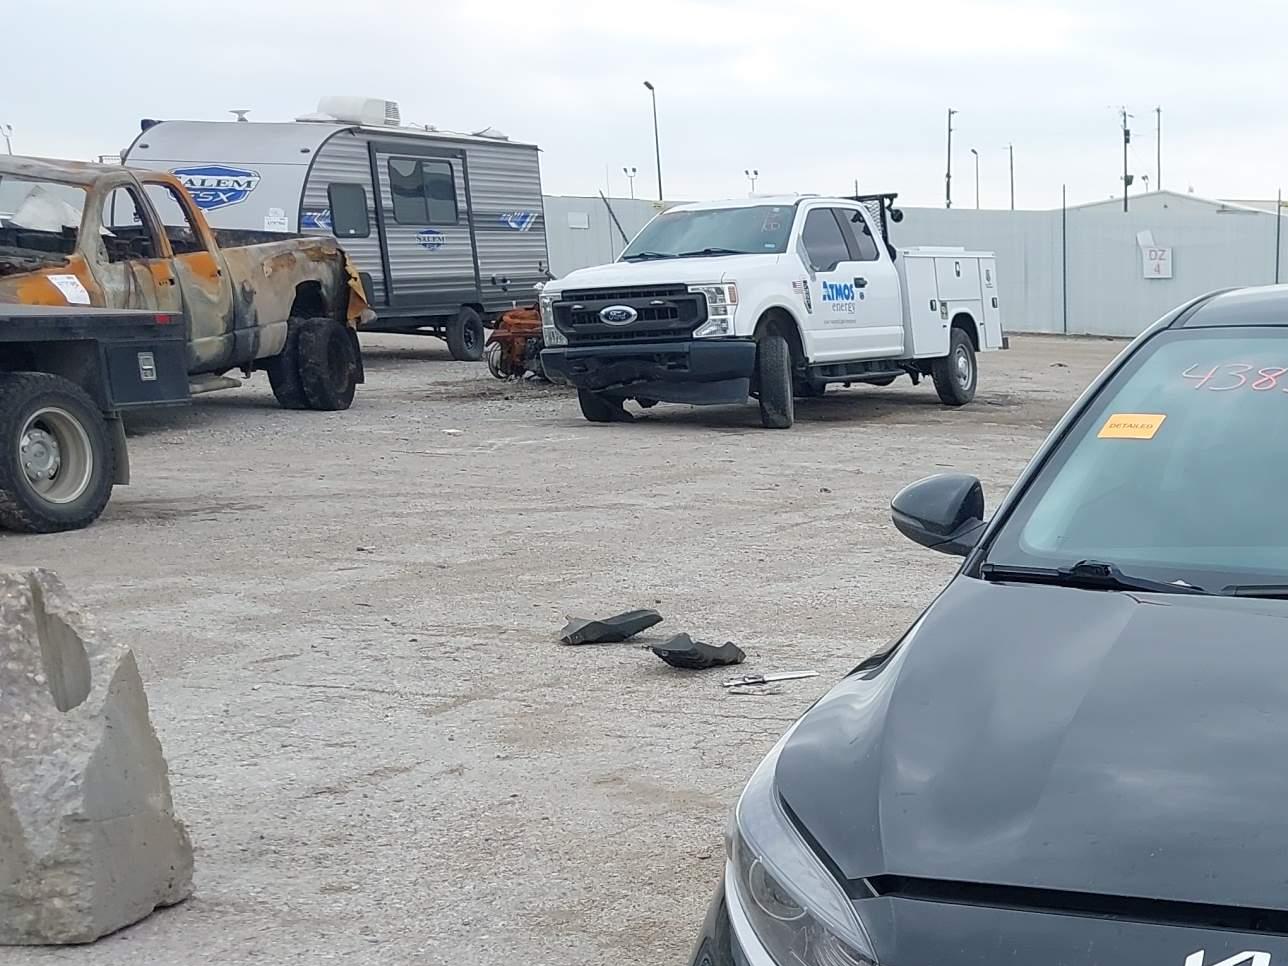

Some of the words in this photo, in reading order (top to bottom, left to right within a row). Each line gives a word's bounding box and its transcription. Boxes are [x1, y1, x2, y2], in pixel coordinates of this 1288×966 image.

[178, 177, 253, 189] ALEM
[823, 281, 854, 301] ATMOS
[832, 303, 855, 313] energy
